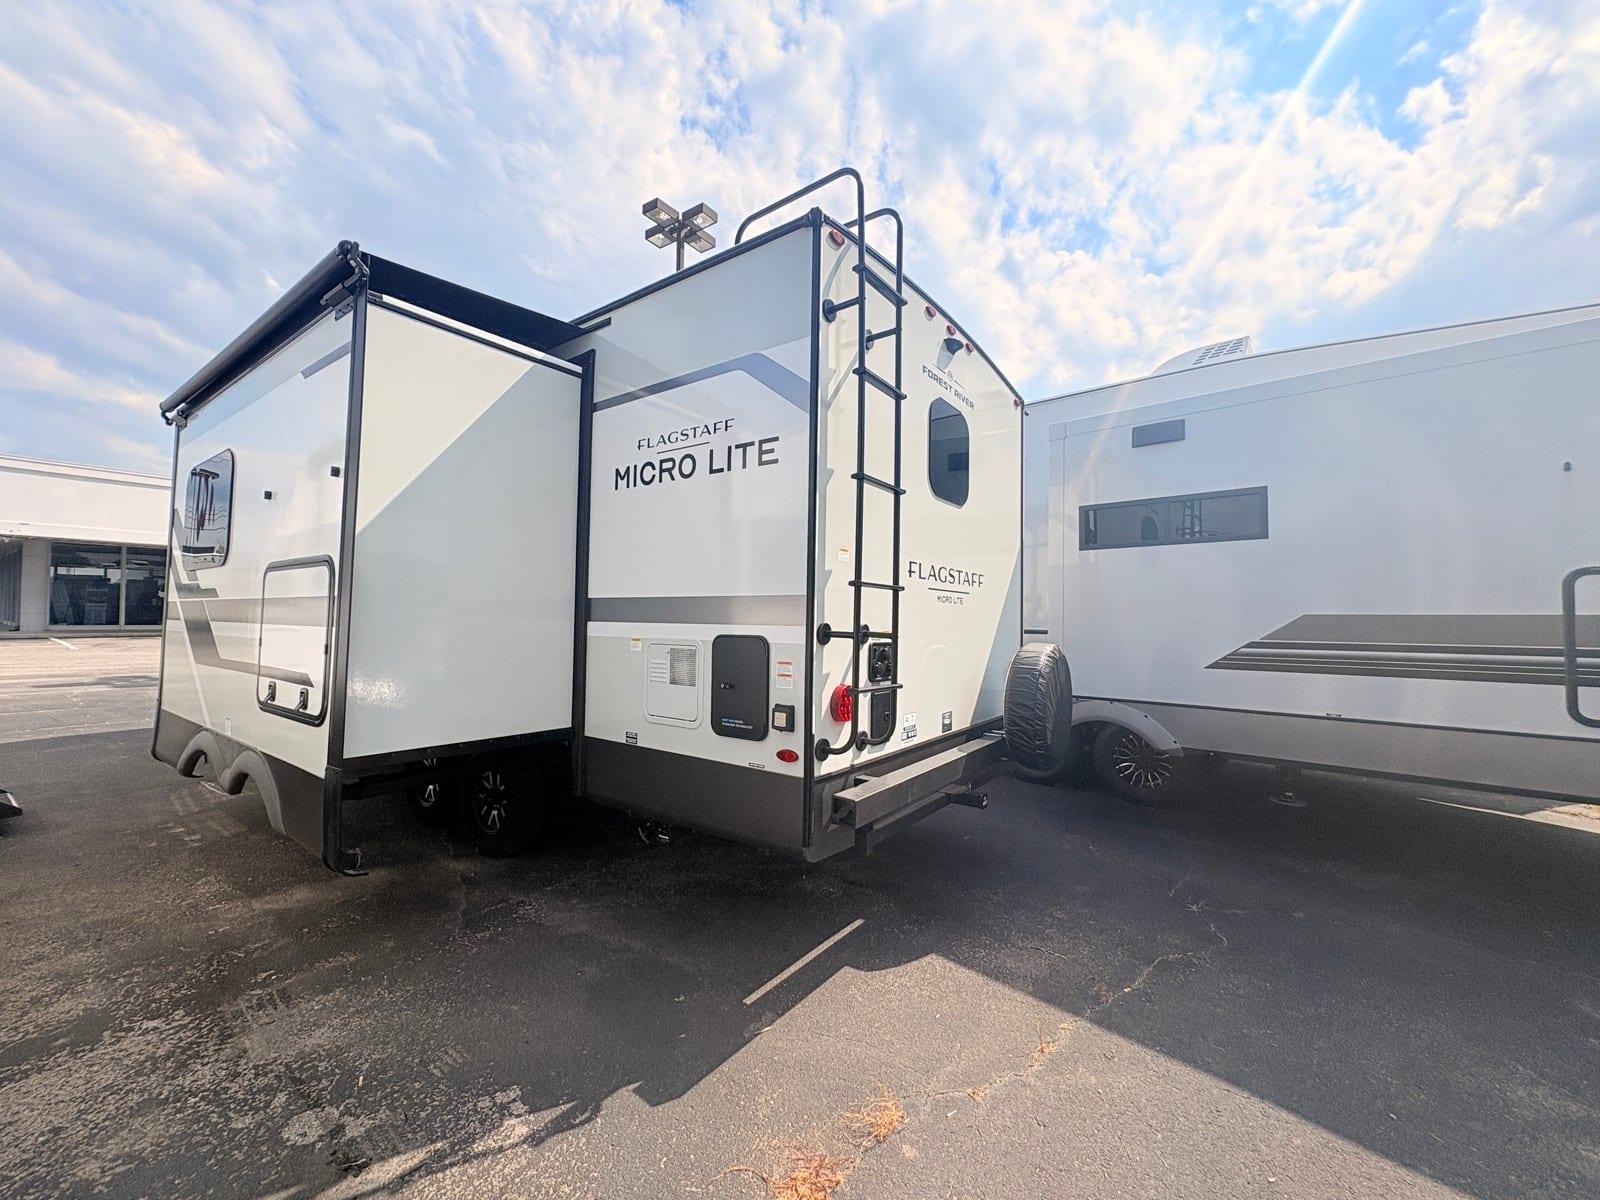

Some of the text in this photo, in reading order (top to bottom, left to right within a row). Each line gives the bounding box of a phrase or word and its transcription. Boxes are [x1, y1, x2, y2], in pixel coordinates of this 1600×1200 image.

[922, 364, 975, 410] FOREST RIVER
[637, 418, 735, 450] FLAGSTAFF
[614, 436, 780, 491] MICRO LITE
[908, 561, 985, 588] FLAGSTAFF
[936, 595, 953, 604] MICRO
